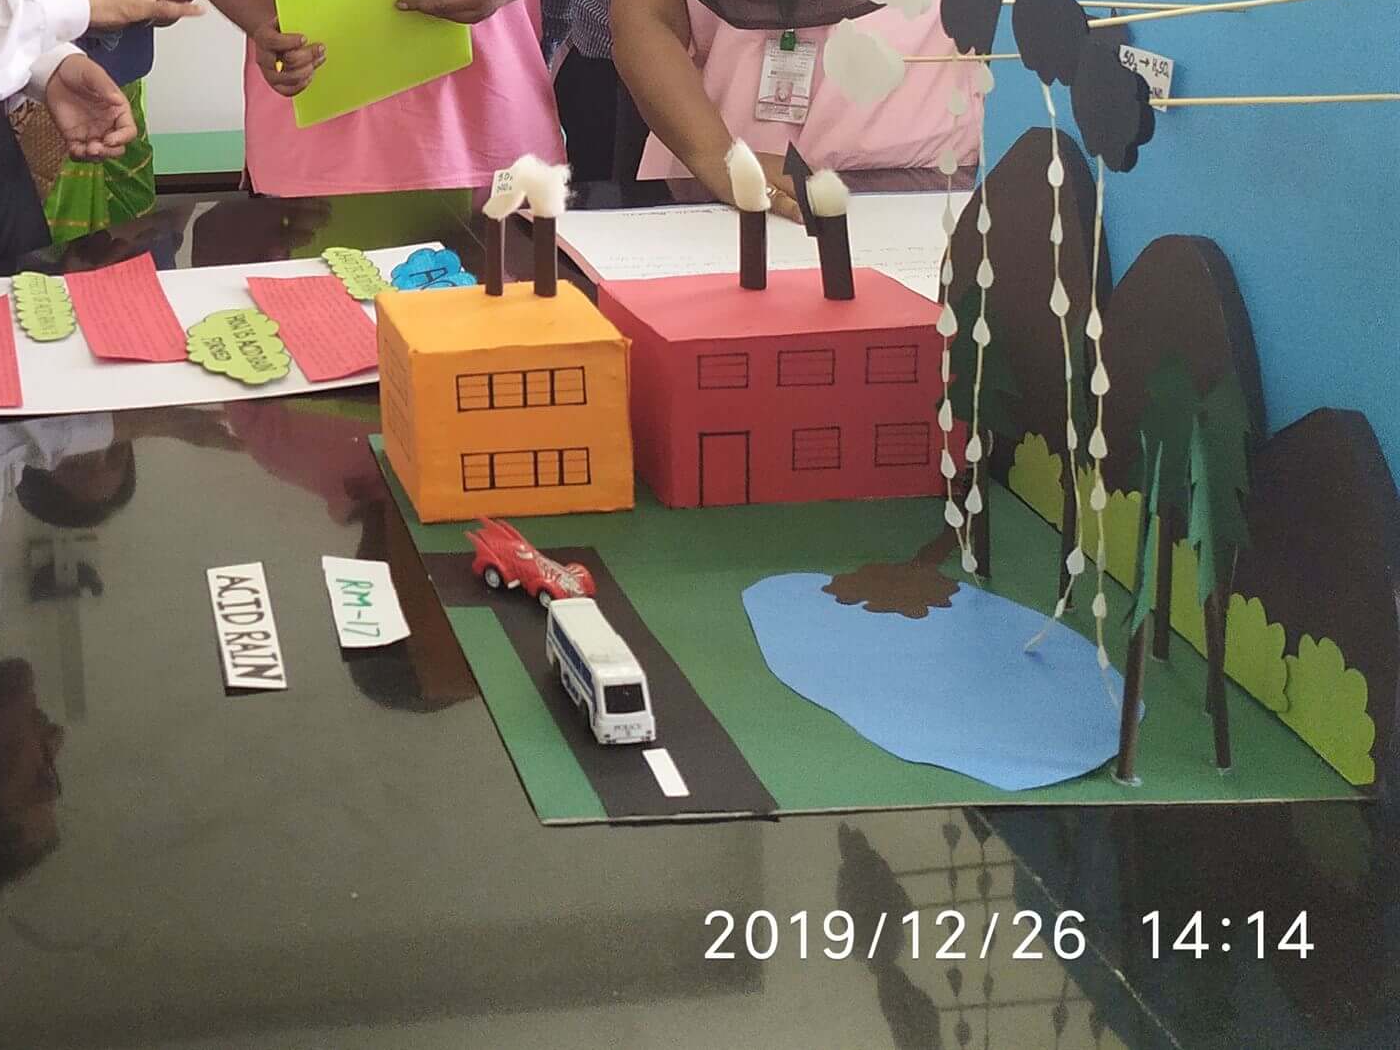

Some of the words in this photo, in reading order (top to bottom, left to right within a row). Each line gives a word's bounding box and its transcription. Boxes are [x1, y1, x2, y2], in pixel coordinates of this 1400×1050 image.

[216, 574, 265, 626] ACID
[335, 578, 381, 638] RM-17
[224, 630, 283, 681] RAIN
